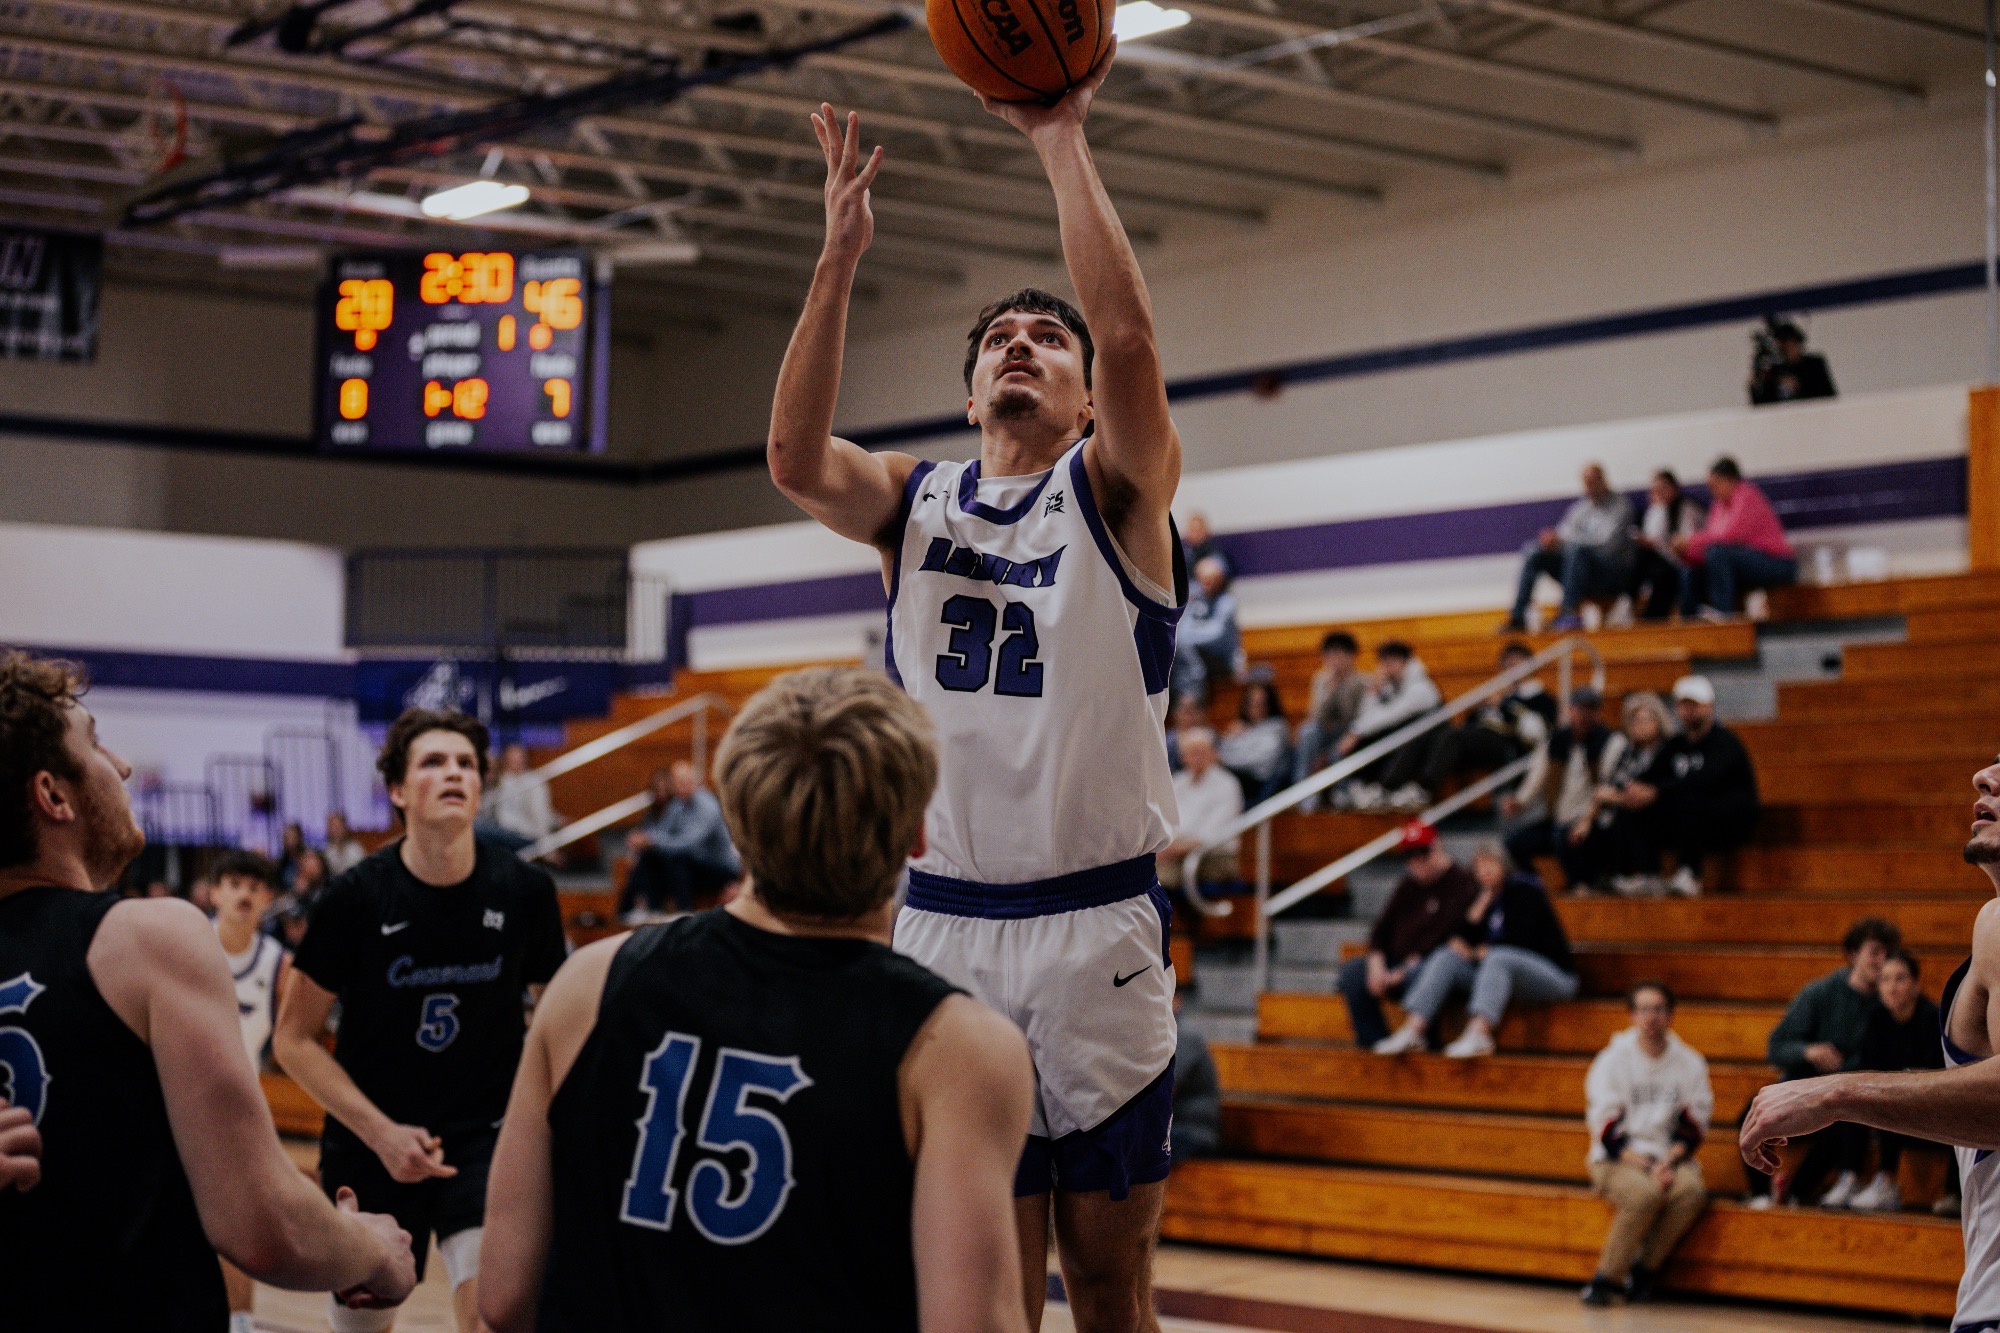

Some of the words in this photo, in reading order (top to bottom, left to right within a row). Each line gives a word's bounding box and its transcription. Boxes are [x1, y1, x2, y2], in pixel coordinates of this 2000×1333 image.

[981, 0, 1033, 57] CAA
[1057, 0, 1085, 46] on
[420, 252, 515, 304] 2:30
[918, 534, 1068, 588] ASURY
[935, 594, 1044, 697] 32
[416, 994, 460, 1052] 5
[619, 1031, 814, 1246] 15
